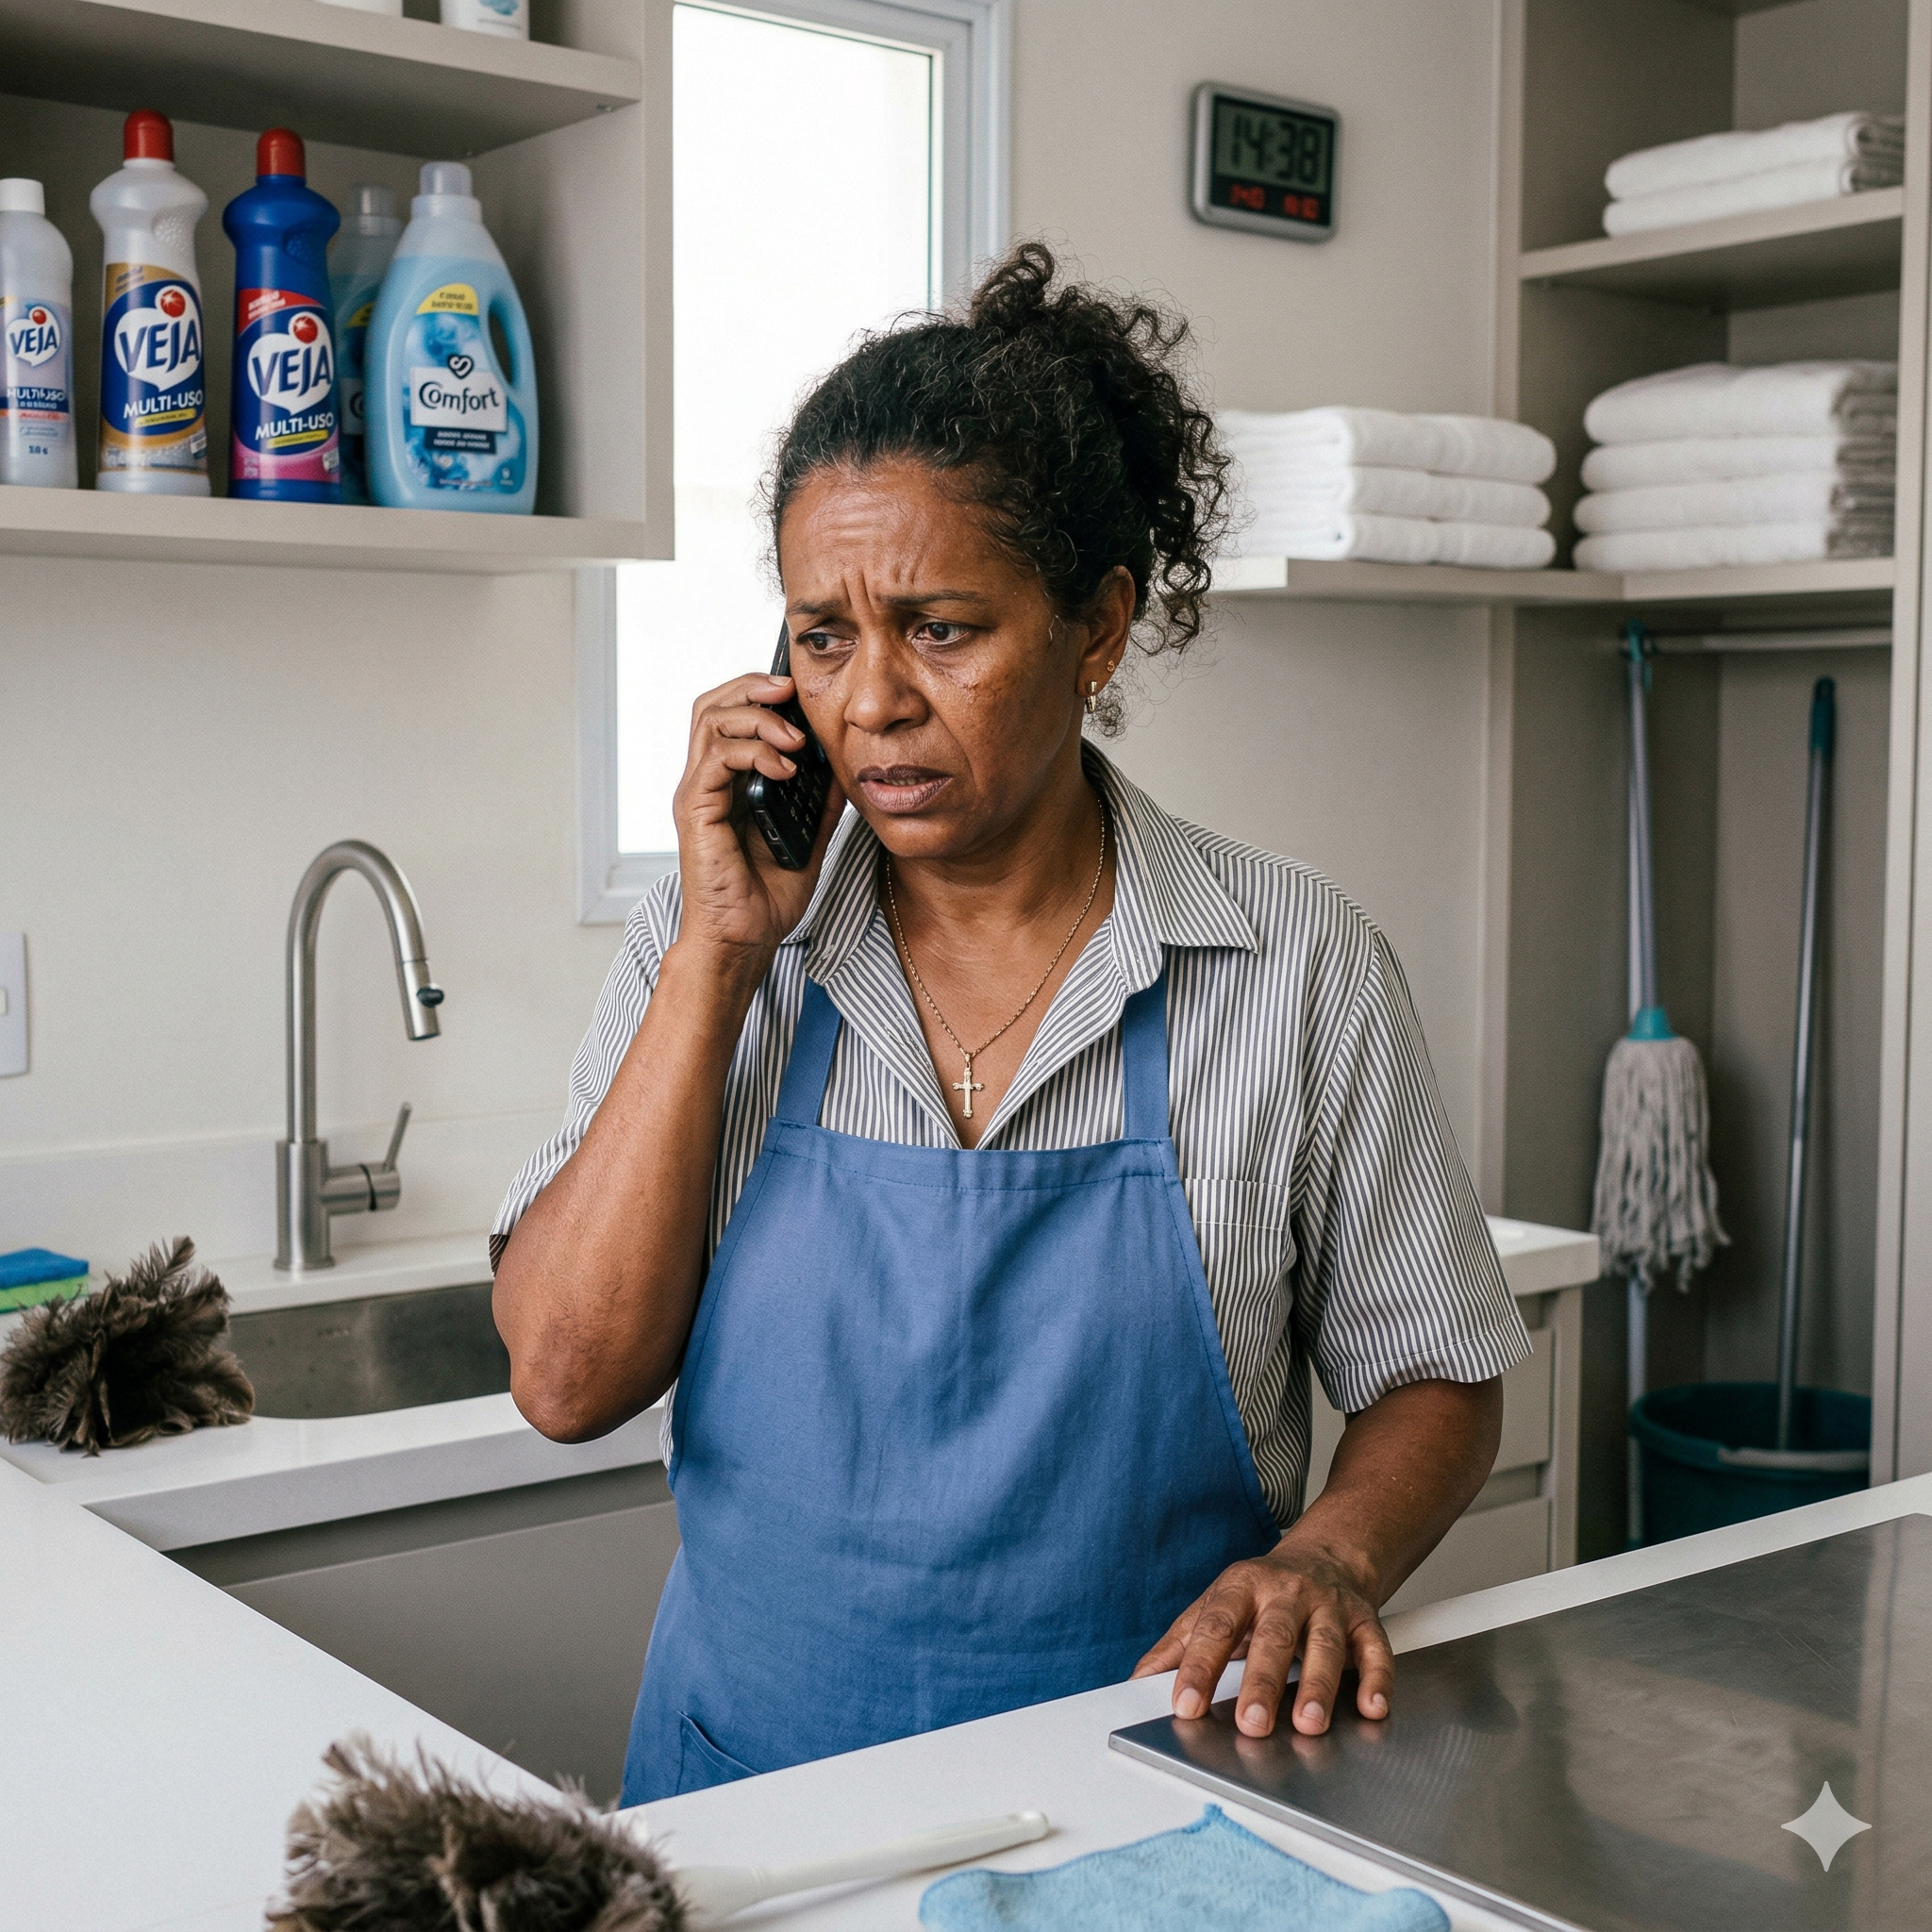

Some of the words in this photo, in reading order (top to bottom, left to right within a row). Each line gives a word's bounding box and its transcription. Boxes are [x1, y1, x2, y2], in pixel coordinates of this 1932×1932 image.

[1231, 112, 1319, 184] 14:38
[9, 325, 58, 357] VEJA
[119, 319, 200, 374] VEJA
[252, 345, 332, 397] VEJA
[123, 389, 204, 419] MULTI-USO
[419, 381, 499, 414] Comfort
[255, 411, 334, 441] MULTI-USO
